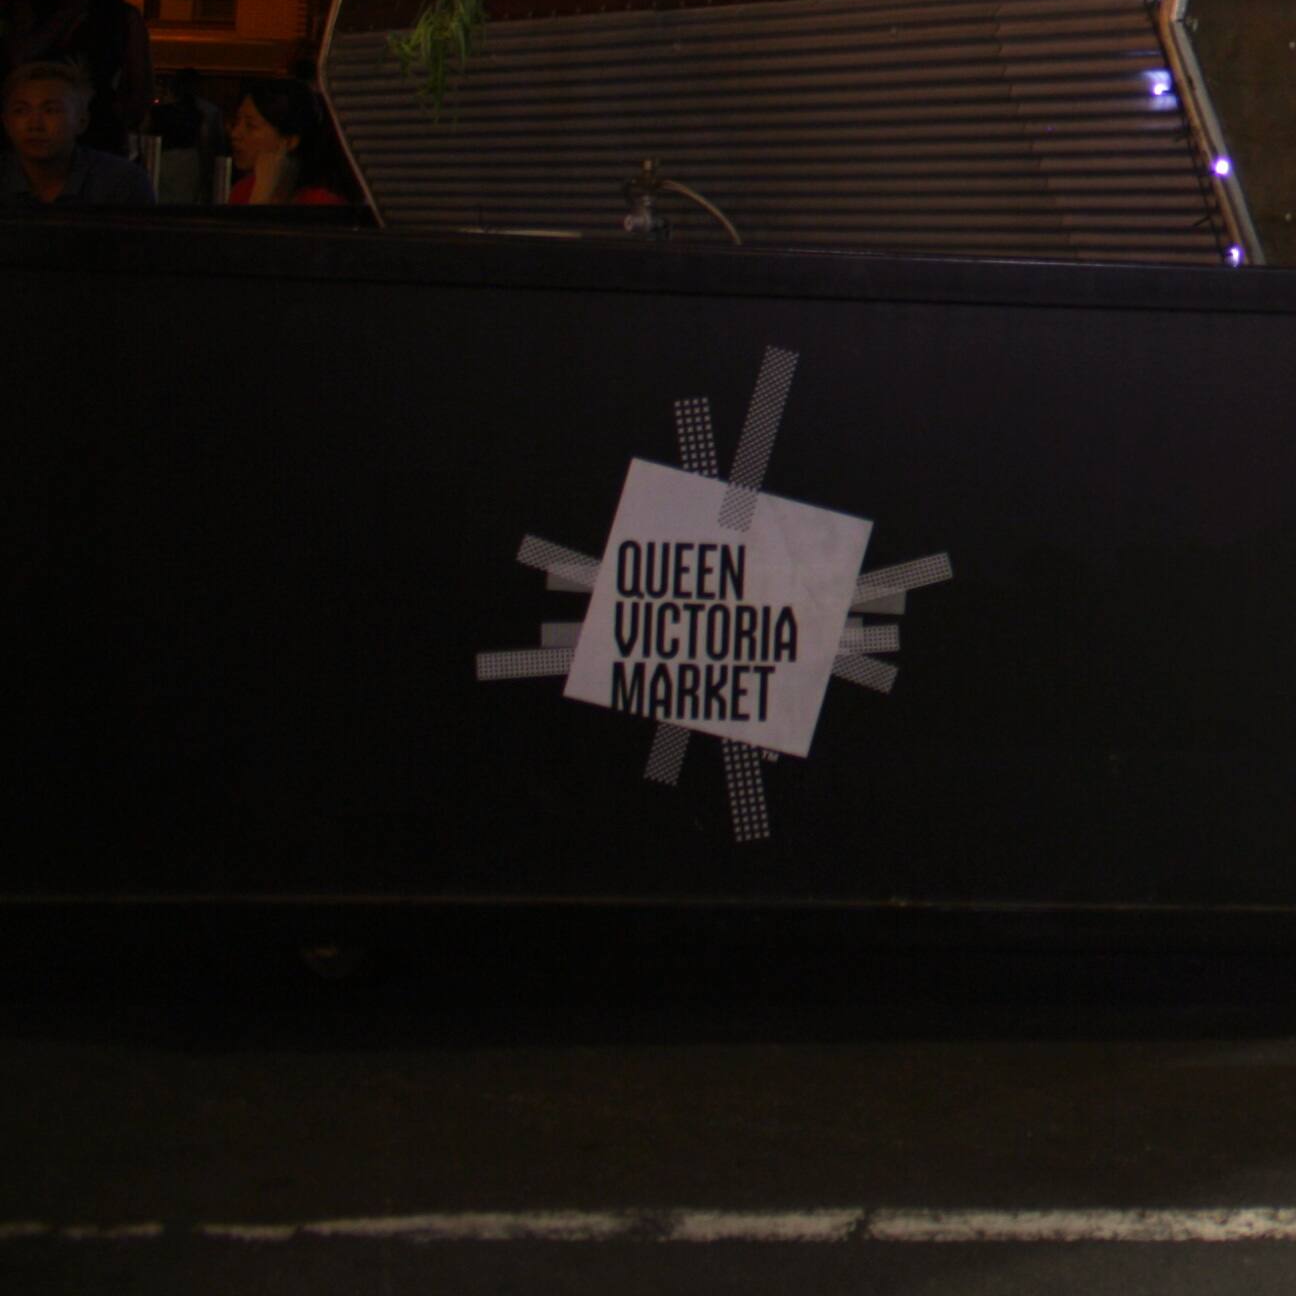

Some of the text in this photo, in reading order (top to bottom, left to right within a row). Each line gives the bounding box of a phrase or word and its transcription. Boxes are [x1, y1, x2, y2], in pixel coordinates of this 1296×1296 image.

[615, 540, 747, 602] QUEEN
[613, 601, 799, 663] VICTORIA
[609, 661, 777, 722] MARKET
